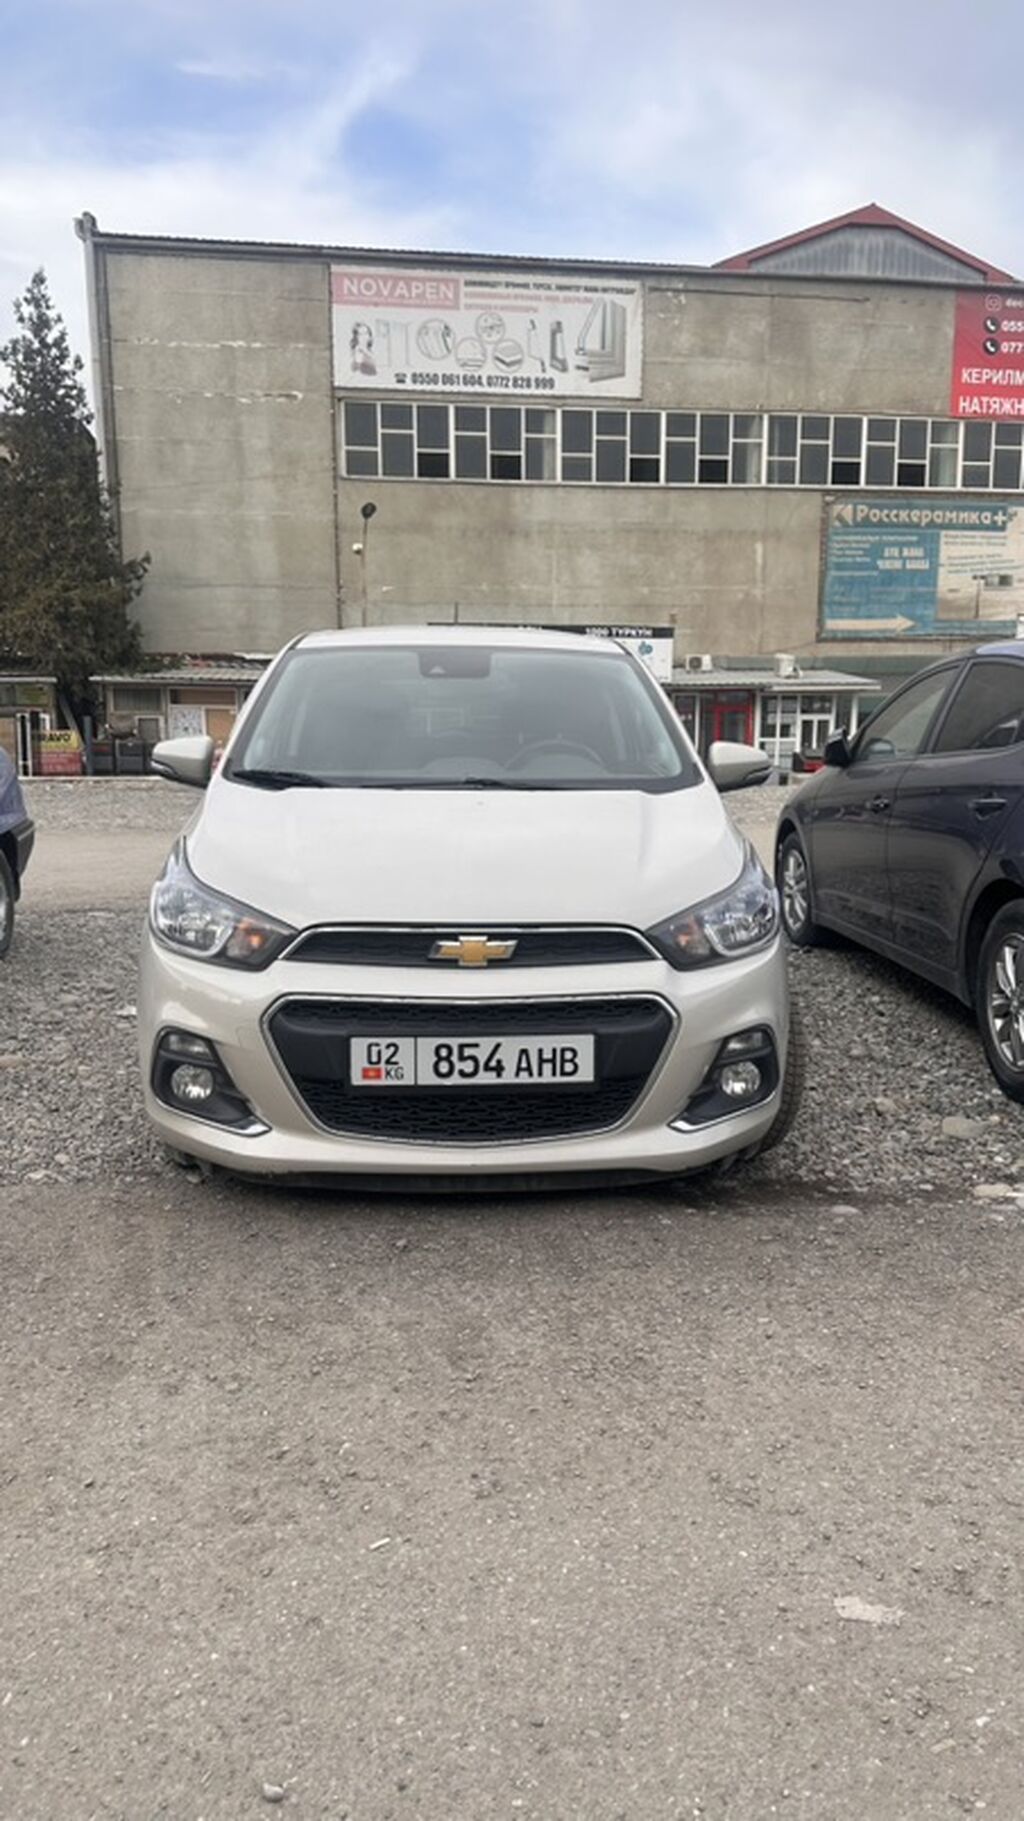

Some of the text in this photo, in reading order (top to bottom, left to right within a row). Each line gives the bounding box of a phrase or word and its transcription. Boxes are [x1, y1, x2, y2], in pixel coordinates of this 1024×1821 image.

[343, 277, 454, 299] NOVAPEN
[959, 396, 1024, 415] НАТЯЖН
[366, 1042, 579, 1079] 02 854 AHB
[384, 1067, 404, 1080] KG
